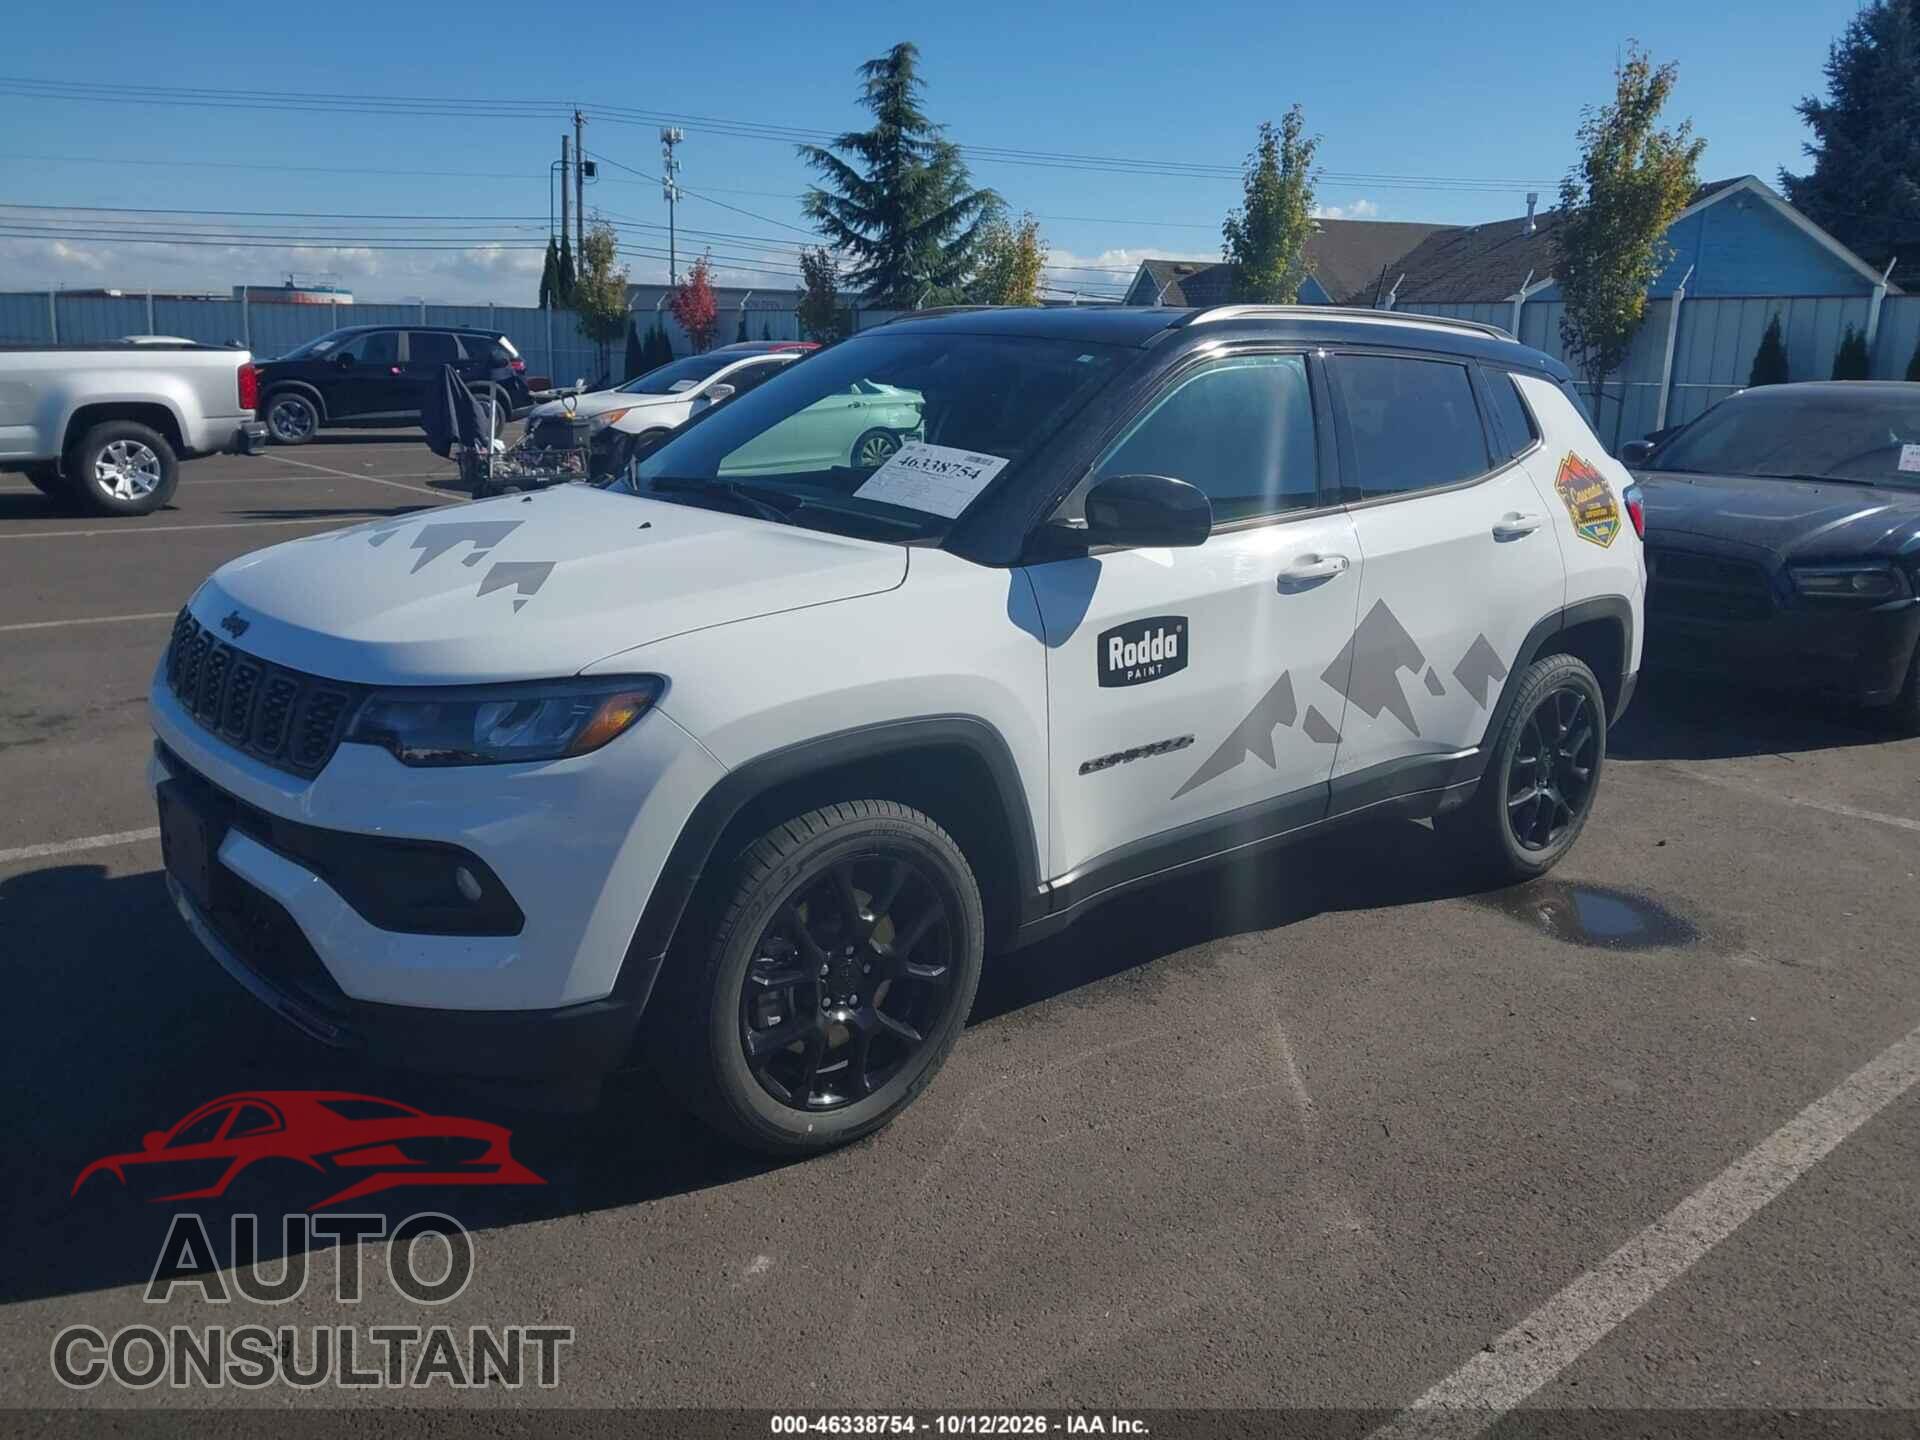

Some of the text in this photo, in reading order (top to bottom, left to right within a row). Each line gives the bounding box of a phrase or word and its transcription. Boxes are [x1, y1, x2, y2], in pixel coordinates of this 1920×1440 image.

[898, 455, 982, 480] 46338754
[1109, 628, 1177, 671] Rodda
[1127, 664, 1163, 680] PAINT
